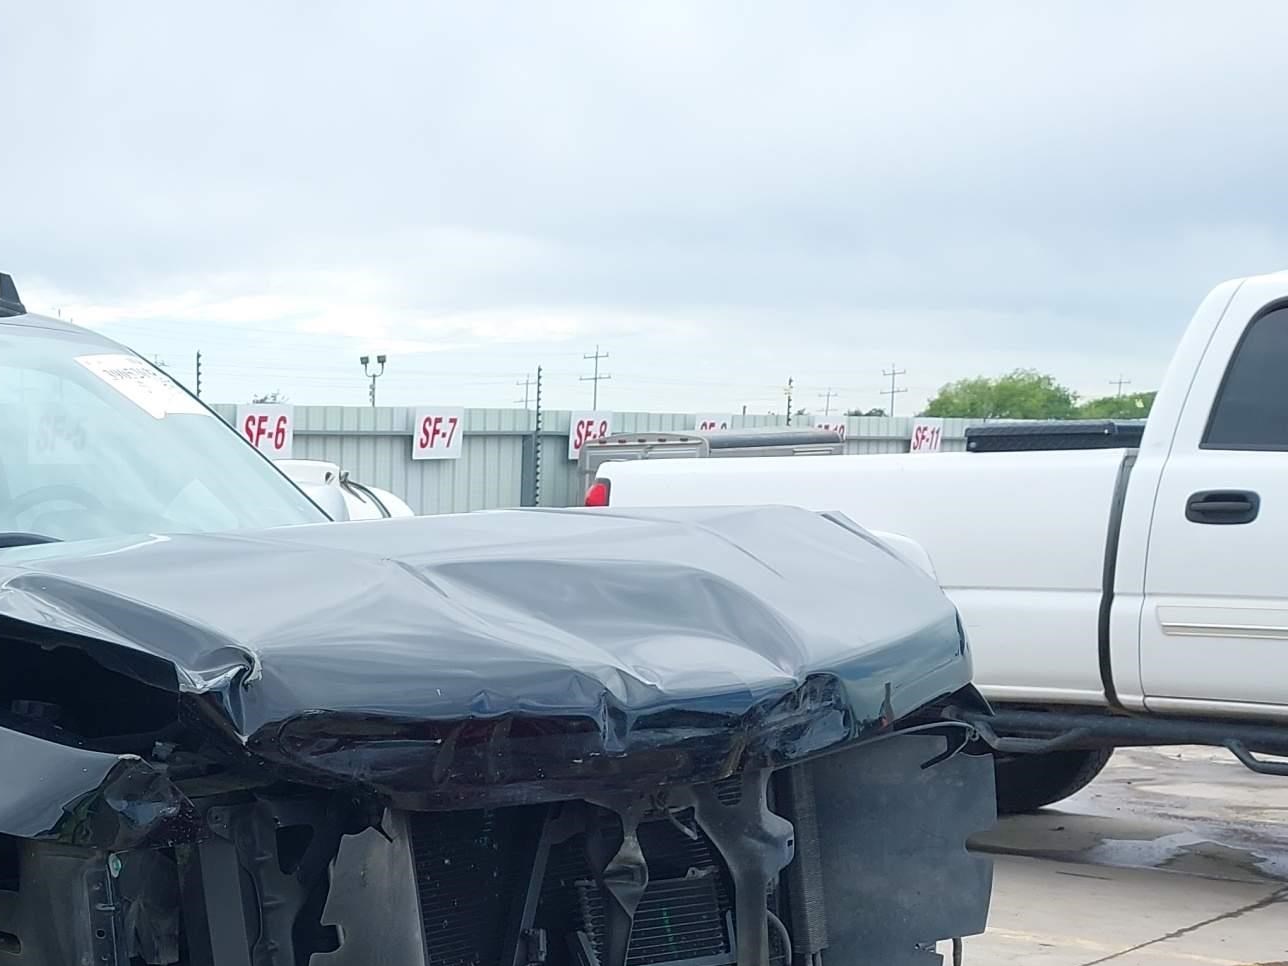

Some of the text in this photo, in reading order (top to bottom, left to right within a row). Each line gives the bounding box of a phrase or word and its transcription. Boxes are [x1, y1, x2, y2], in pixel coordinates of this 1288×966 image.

[244, 414, 288, 450] SF-6
[419, 416, 458, 449] SF-7
[912, 425, 942, 450] SF-11
